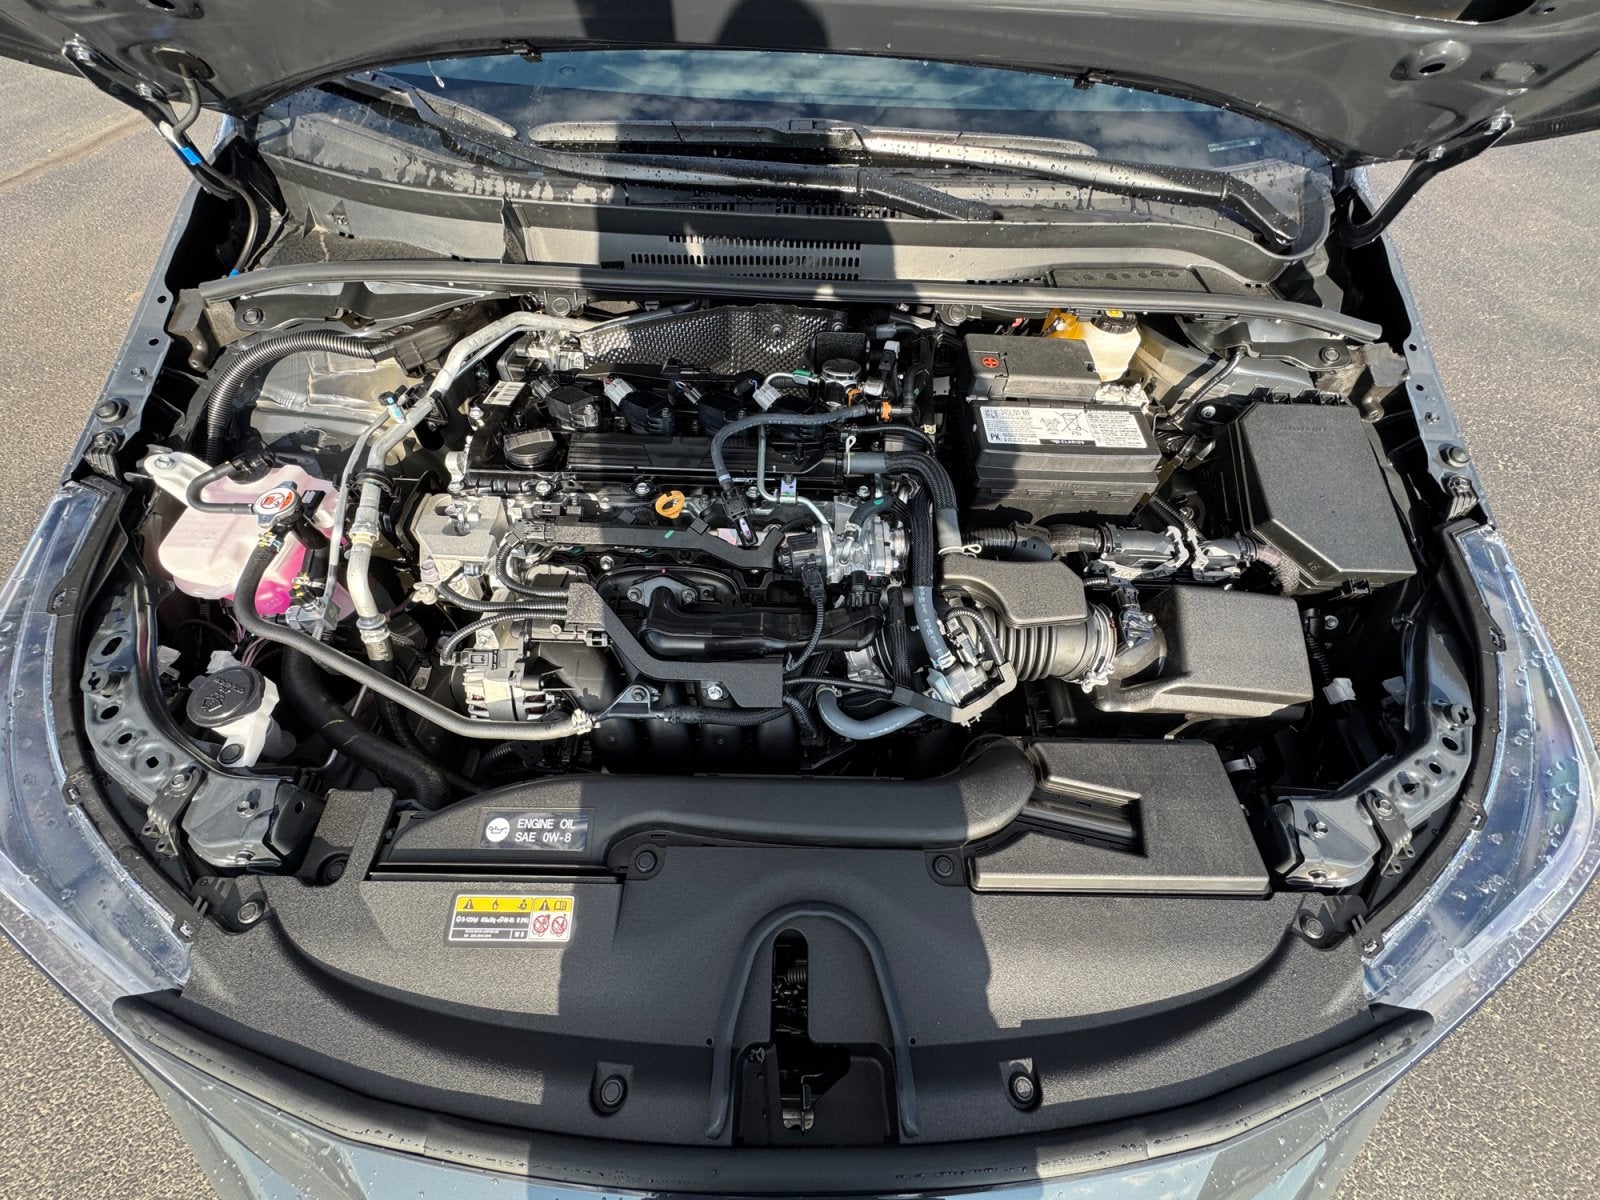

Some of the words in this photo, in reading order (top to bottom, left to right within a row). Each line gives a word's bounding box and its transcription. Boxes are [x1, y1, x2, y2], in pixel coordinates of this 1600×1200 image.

[990, 433, 1001, 441] PK
[517, 818, 554, 829] ENGINE
[559, 818, 576, 829] OIL
[514, 831, 537, 842] SAE
[542, 832, 572, 843] 0W-8
